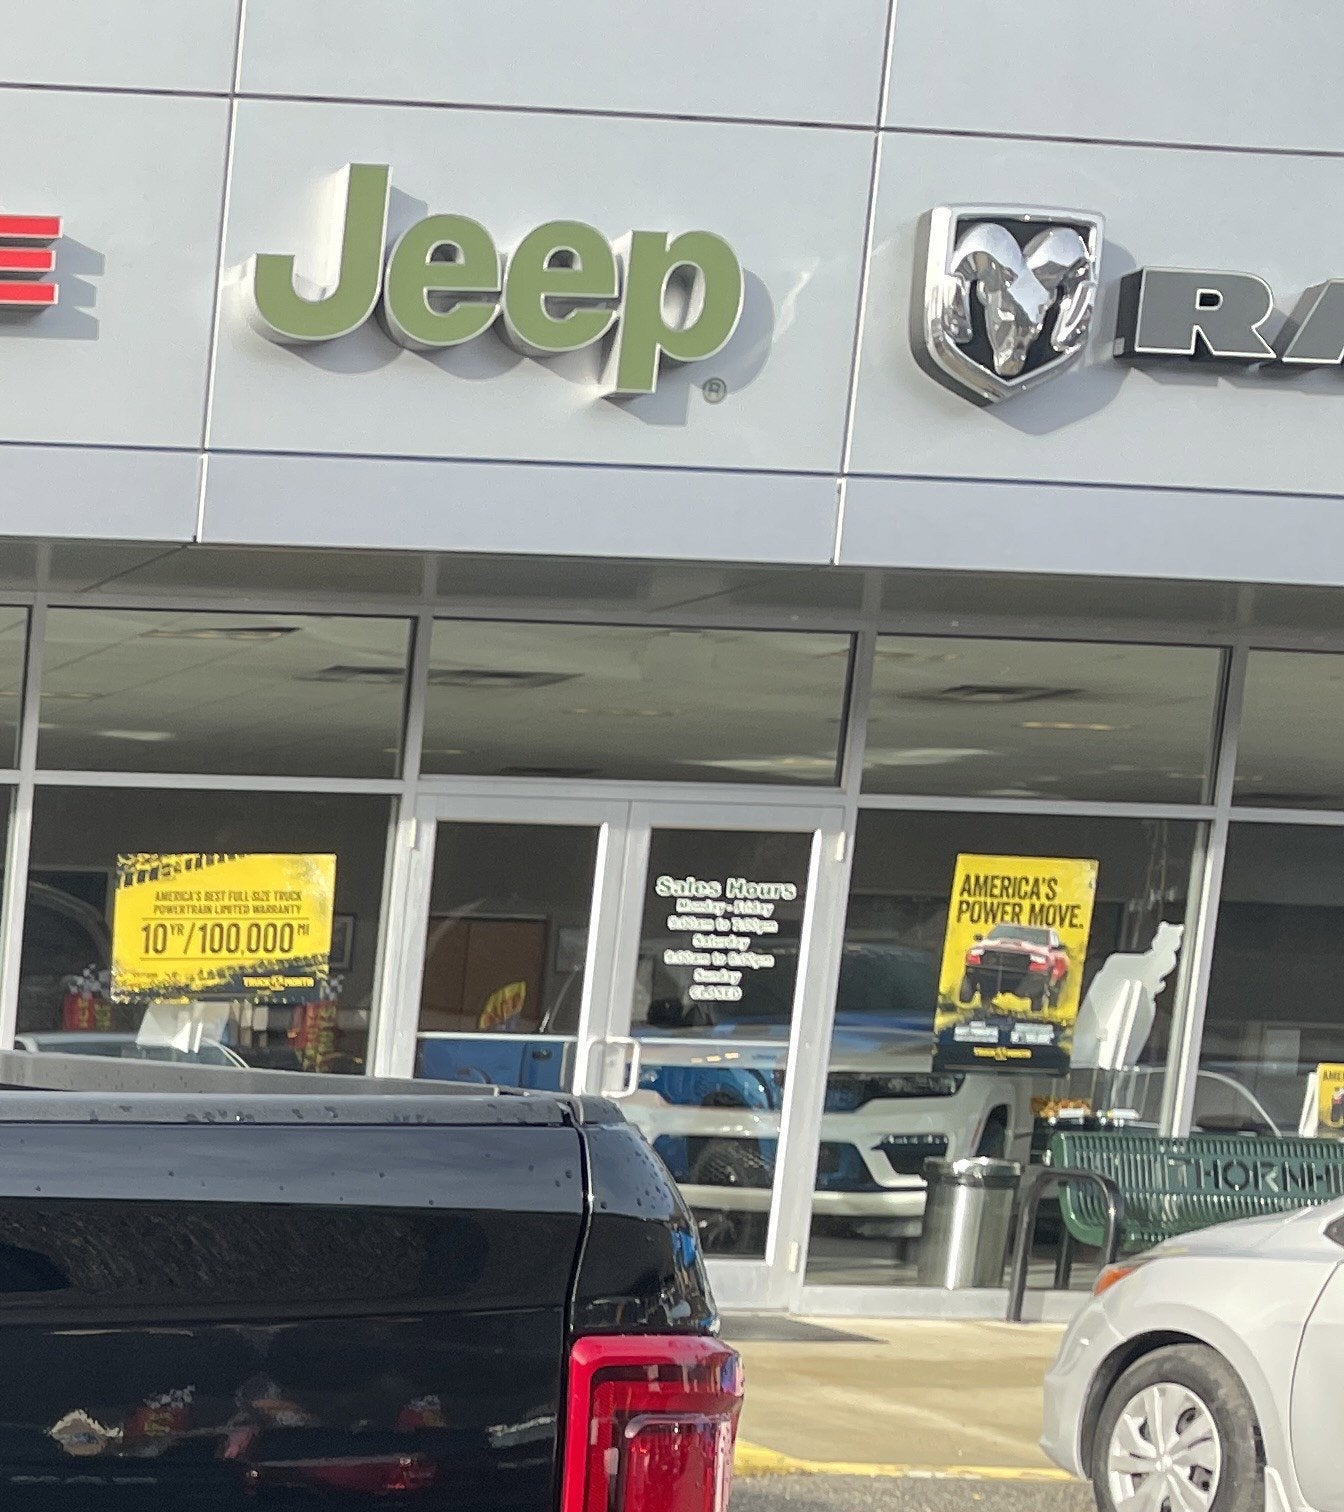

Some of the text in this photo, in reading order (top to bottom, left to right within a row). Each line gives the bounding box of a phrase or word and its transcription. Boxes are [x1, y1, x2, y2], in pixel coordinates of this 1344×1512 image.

[249, 163, 746, 397] Jeep
[655, 876, 797, 900] Sales Hours
[959, 873, 1058, 902] AMERICA'S
[956, 900, 1084, 929] POWER MOVE.
